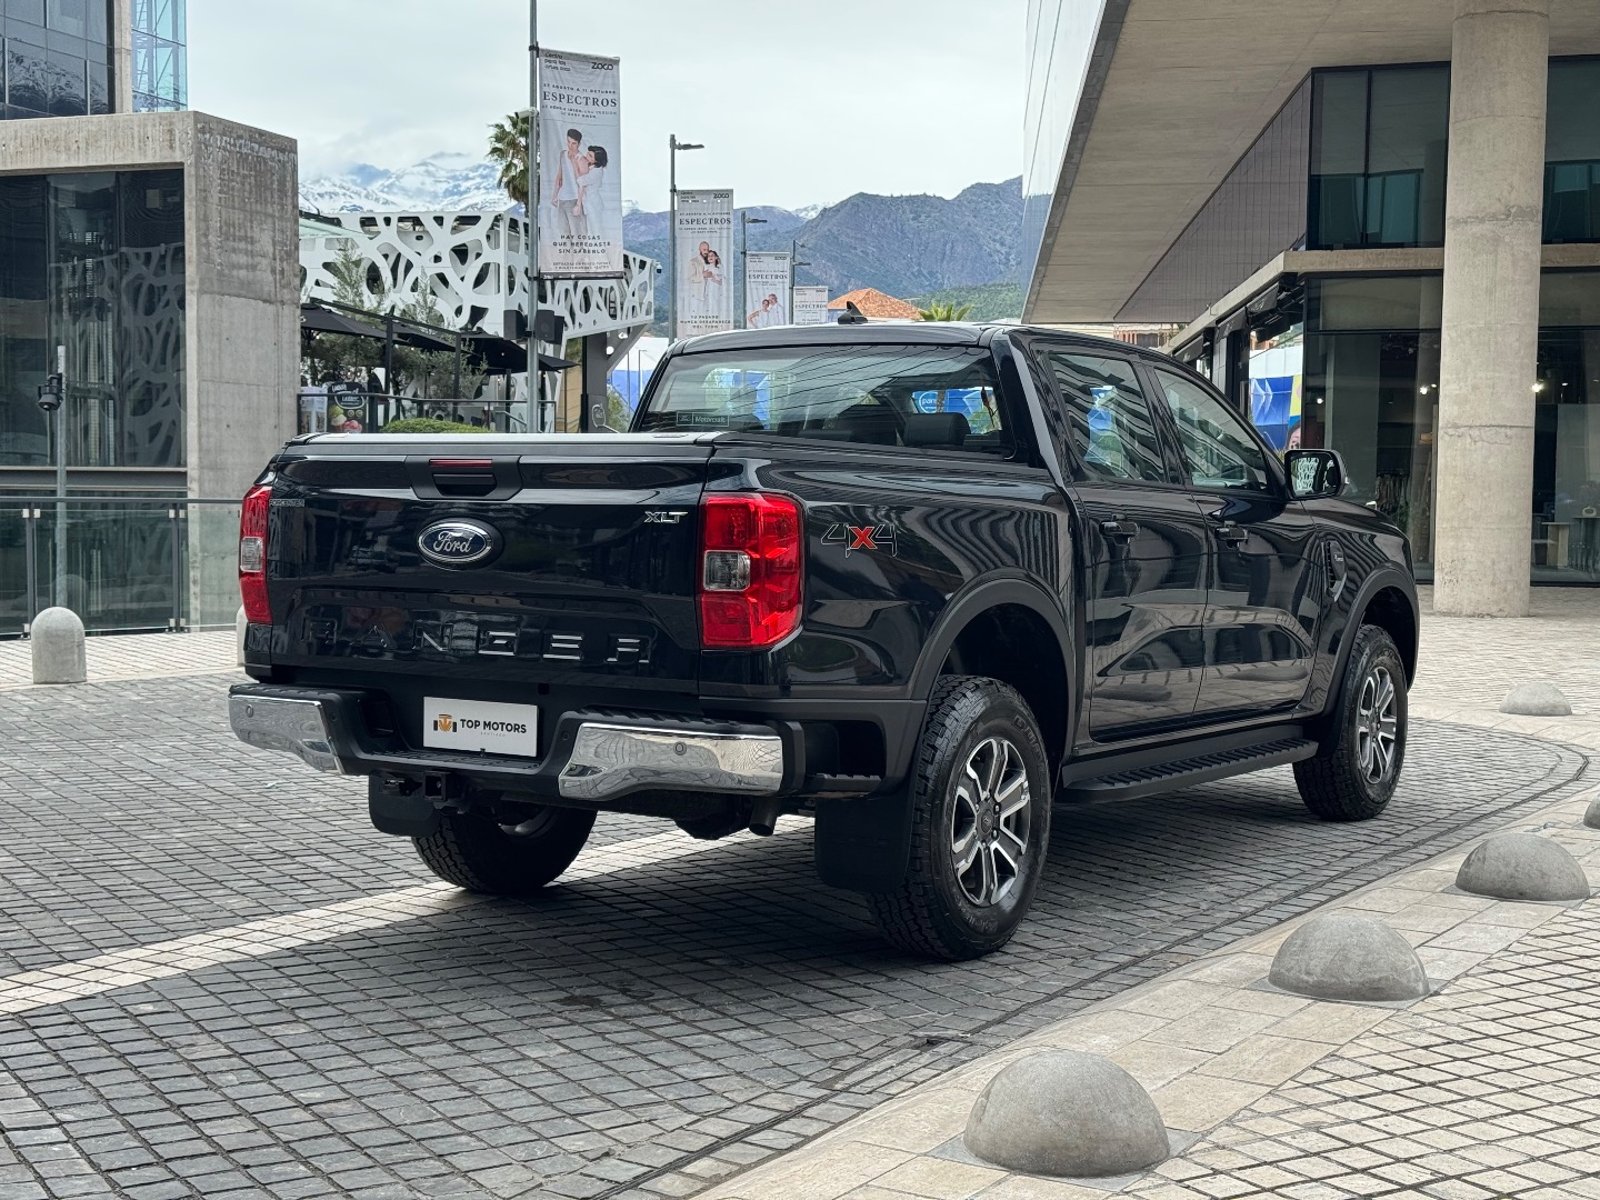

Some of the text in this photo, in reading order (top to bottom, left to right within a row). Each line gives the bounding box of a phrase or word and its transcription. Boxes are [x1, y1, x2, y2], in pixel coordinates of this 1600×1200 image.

[592, 62, 614, 70] ZOCO
[543, 91, 617, 108] ESPECTROS
[643, 511, 688, 524] XLT
[432, 530, 473, 552] Ford
[301, 617, 651, 664] RANGER
[460, 718, 527, 734] TOP MOTORS
